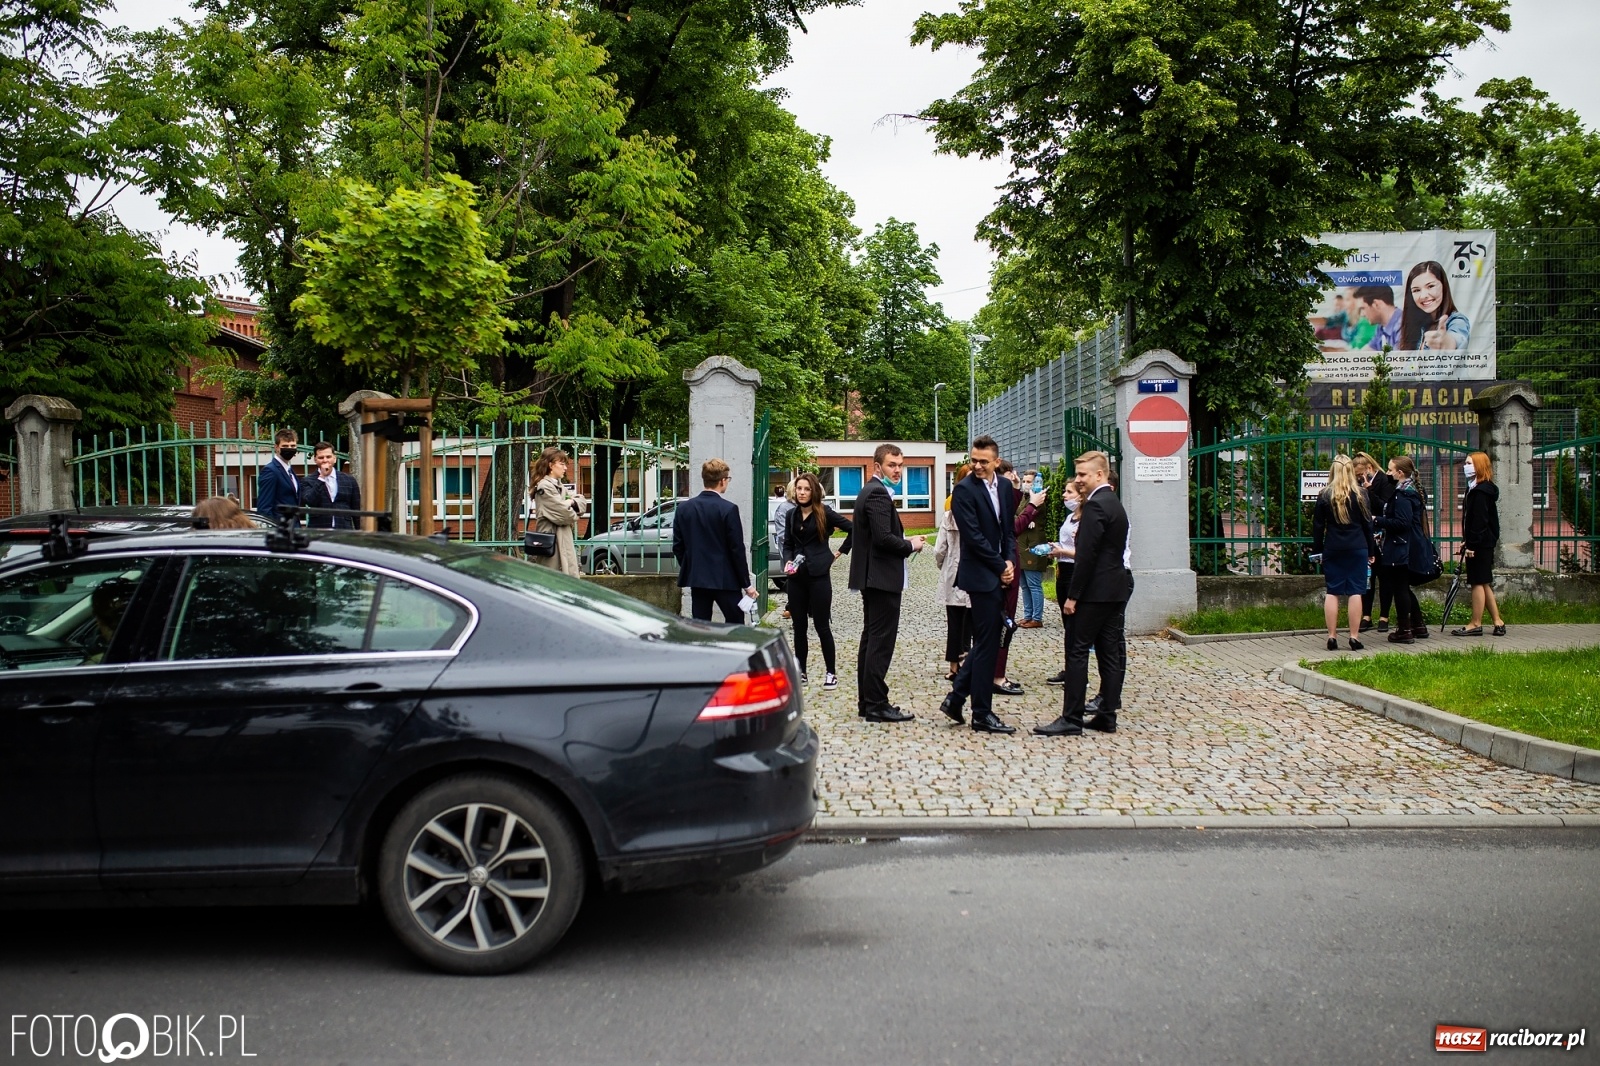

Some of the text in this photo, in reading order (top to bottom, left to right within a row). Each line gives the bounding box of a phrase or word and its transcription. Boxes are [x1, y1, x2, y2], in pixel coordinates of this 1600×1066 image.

[1338, 274, 1397, 284] otwiera umysły
[1326, 356, 1352, 364] ZKÓŁ
[1154, 383, 1162, 392] 11
